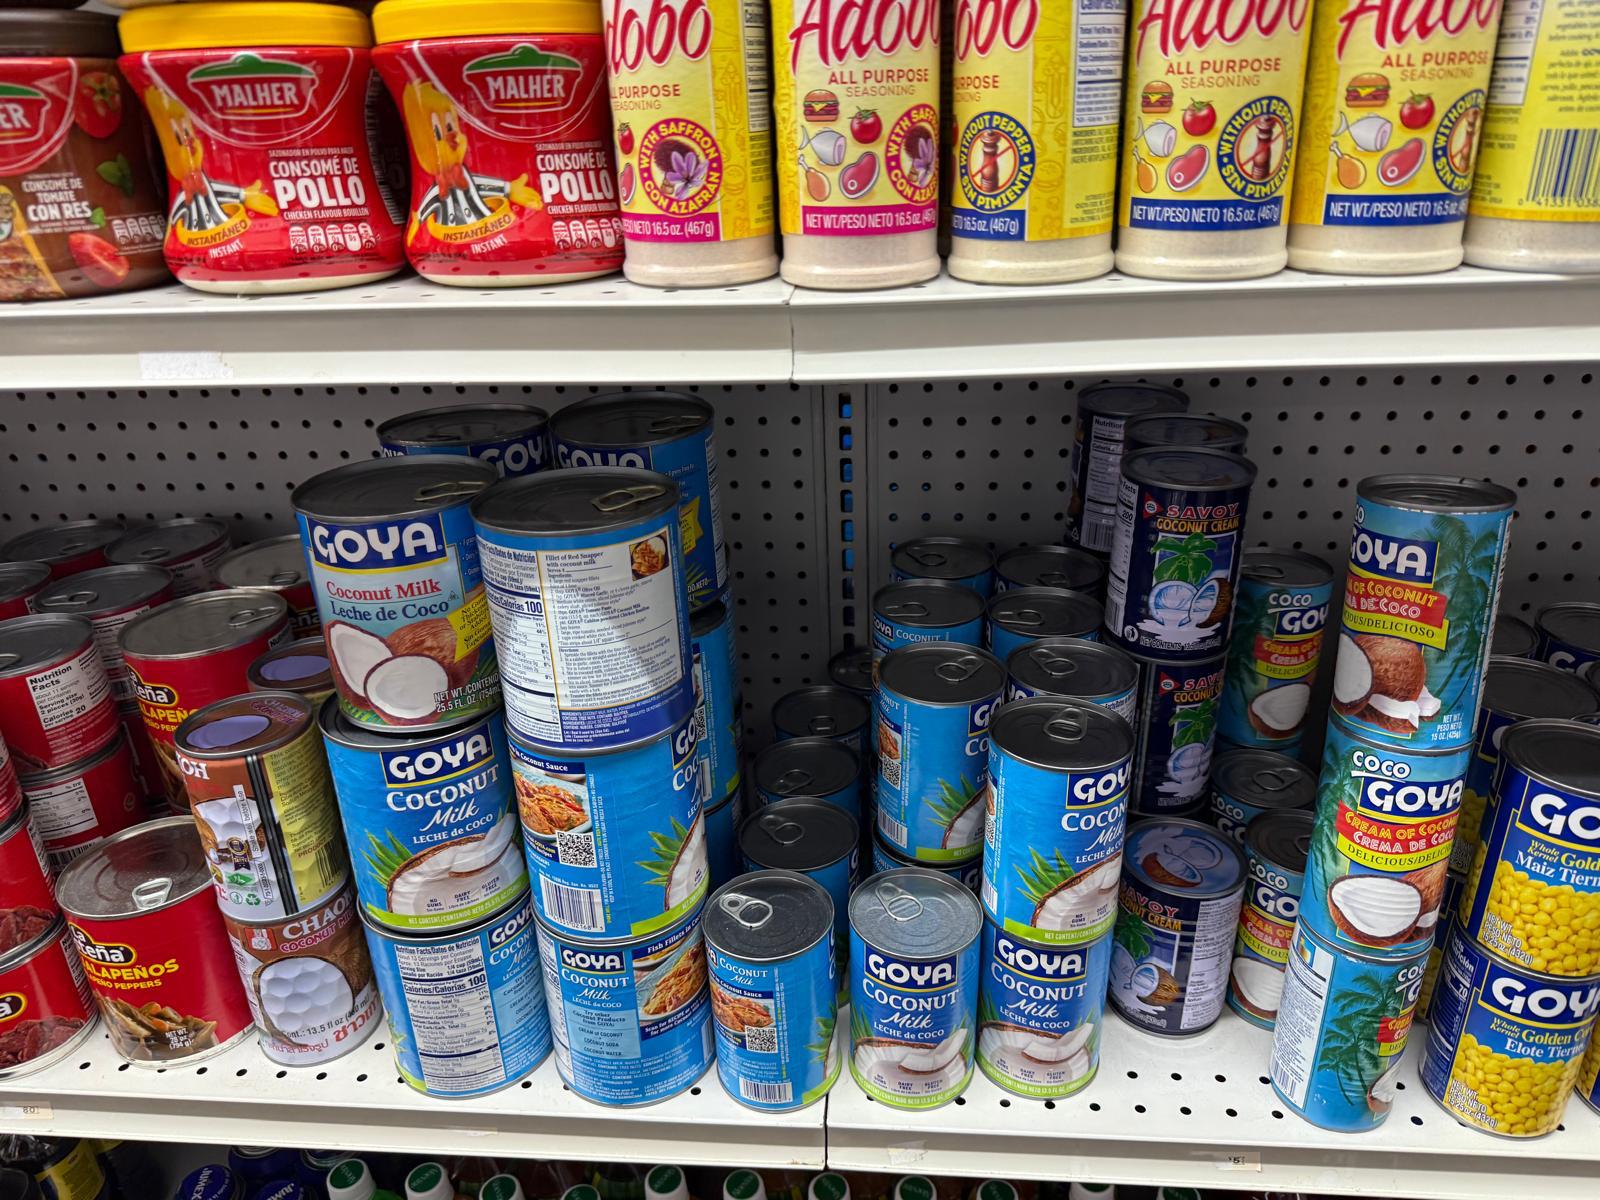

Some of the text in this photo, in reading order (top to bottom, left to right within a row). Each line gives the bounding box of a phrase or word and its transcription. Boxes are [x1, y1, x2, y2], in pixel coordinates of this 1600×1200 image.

[1165, 57, 1281, 76] ALL PURPOSE
[1381, 51, 1488, 68] ALL PURPOSE
[828, 68, 929, 85] ALL PURPOSE
[1181, 75, 1260, 89] SEASONING
[1399, 67, 1474, 82] SEASONING
[210, 82, 300, 107] MALHER
[486, 74, 566, 101] MALHER
[618, 84, 680, 99] PURPOSE
[846, 85, 916, 98] SEASONING
[887, 117, 913, 157] WITH
[1219, 99, 1268, 155] WITHOUT
[639, 132, 664, 168] WITH
[659, 121, 720, 164] SAFFRON
[959, 115, 991, 166] WITHOUT
[993, 114, 1031, 154] PEPPER
[269, 156, 360, 178] CONSOMÉ DE
[536, 150, 595, 172] CONSOMÉ
[1435, 157, 1452, 184] SIN
[540, 169, 615, 204] POLLO
[890, 168, 913, 200] CON
[962, 174, 976, 204] SIN
[976, 162, 1034, 209] PIMIENTA
[1221, 165, 1245, 192] SIN
[273, 175, 367, 210] POLLO
[643, 171, 721, 215] CON AZAFRAN
[27, 202, 93, 221] CON RES
[283, 209, 343, 220] CHICKEN FLAVOUR
[547, 205, 574, 215] CHICKEN
[806, 213, 823, 228] NET
[868, 212, 894, 228] NETO
[894, 211, 912, 227] 16.5
[1132, 205, 1148, 219] NET
[1193, 206, 1220, 222] NETO
[1222, 206, 1243, 223] 16.5
[1329, 202, 1351, 217] NET
[1404, 201, 1431, 217] NETO
[186, 219, 249, 246] INSTANTÁNEO
[442, 213, 512, 242] INSTANTÁNEO
[651, 220, 671, 236] 16.5
[684, 220, 714, 239] (467g)
[990, 217, 1019, 235] (467g)
[209, 240, 244, 259] INSTANT
[471, 233, 508, 254] INSTANT
[1166, 502, 1241, 520] SAVOY
[1156, 517, 1240, 533] COCONUT CREAM
[313, 521, 437, 564] GOYA
[567, 551, 579, 560] Red
[326, 578, 442, 602] Coconut Milk
[1268, 593, 1312, 607] COCO
[1367, 581, 1440, 608] COCONUT
[330, 600, 449, 622] Leche de Coco
[524, 601, 544, 615] 100
[1379, 597, 1421, 619] COCO
[29, 664, 73, 686] Nutrition
[32, 678, 61, 693] Facts
[433, 690, 450, 703] NET
[43, 704, 87, 725] Calories 20
[436, 701, 454, 714] 25.5
[1436, 724, 1450, 733] PESO
[1443, 714, 1452, 724] NET
[389, 734, 489, 781] GOYA
[520, 752, 569, 773] Coconut Sauce
[1352, 750, 1412, 779] COCO
[386, 764, 499, 812] COCONUT
[1367, 780, 1463, 814] GOYA
[419, 798, 480, 833] Milk
[1211, 791, 1245, 821] COCO
[412, 813, 494, 845] LECHE de COCO
[1345, 811, 1416, 843] CREAM OF
[1353, 831, 1427, 855] CREMA DE
[1530, 840, 1560, 858] Whole
[1075, 850, 1105, 865] LECHE
[1516, 850, 1556, 881] Maiz
[1527, 847, 1560, 866] Kernel
[1249, 858, 1289, 891] COCO
[1148, 913, 1183, 932] CREAM
[1486, 912, 1500, 925] NET
[70, 925, 87, 943] La
[280, 924, 336, 953] COCONUT
[647, 930, 686, 955] Fish Fillets
[1247, 922, 1284, 951] CREMA
[1276, 927, 1292, 942] OF
[1483, 920, 1523, 949] PESO NETO
[562, 949, 621, 970] GOYA
[997, 938, 1083, 976] GOYA
[1507, 947, 1535, 967] (432g)
[561, 968, 630, 989] COCONUT
[719, 957, 769, 979] COCONUT
[868, 953, 953, 986] GOYA
[115, 978, 163, 990] PEPPERS
[468, 974, 486, 987] 100
[720, 979, 764, 999] Coconut Sauce
[731, 974, 757, 988] Milk
[990, 961, 1088, 1002] COCONUT
[1459, 983, 1468, 999] 70
[572, 996, 622, 1009] LECHE COCO
[577, 987, 612, 1000] Milk
[862, 978, 960, 1012] COCONUT
[999, 1006, 1071, 1030] LECHE de COCO
[1006, 998, 1060, 1020] Milk
[307, 1017, 345, 1037] 13.5 fl oz
[873, 1022, 945, 1041] LECHE de COCO
[879, 1011, 935, 1032] Milk
[1493, 1017, 1521, 1034] Whole
[165, 1030, 177, 1039] NET
[1490, 1023, 1573, 1048] Kernel Golden
[1505, 1038, 1544, 1060] Elote
[1451, 1079, 1465, 1092] NET
[1449, 1088, 1488, 1113] PESO NETO
[1474, 1111, 1499, 1129] (432g)
